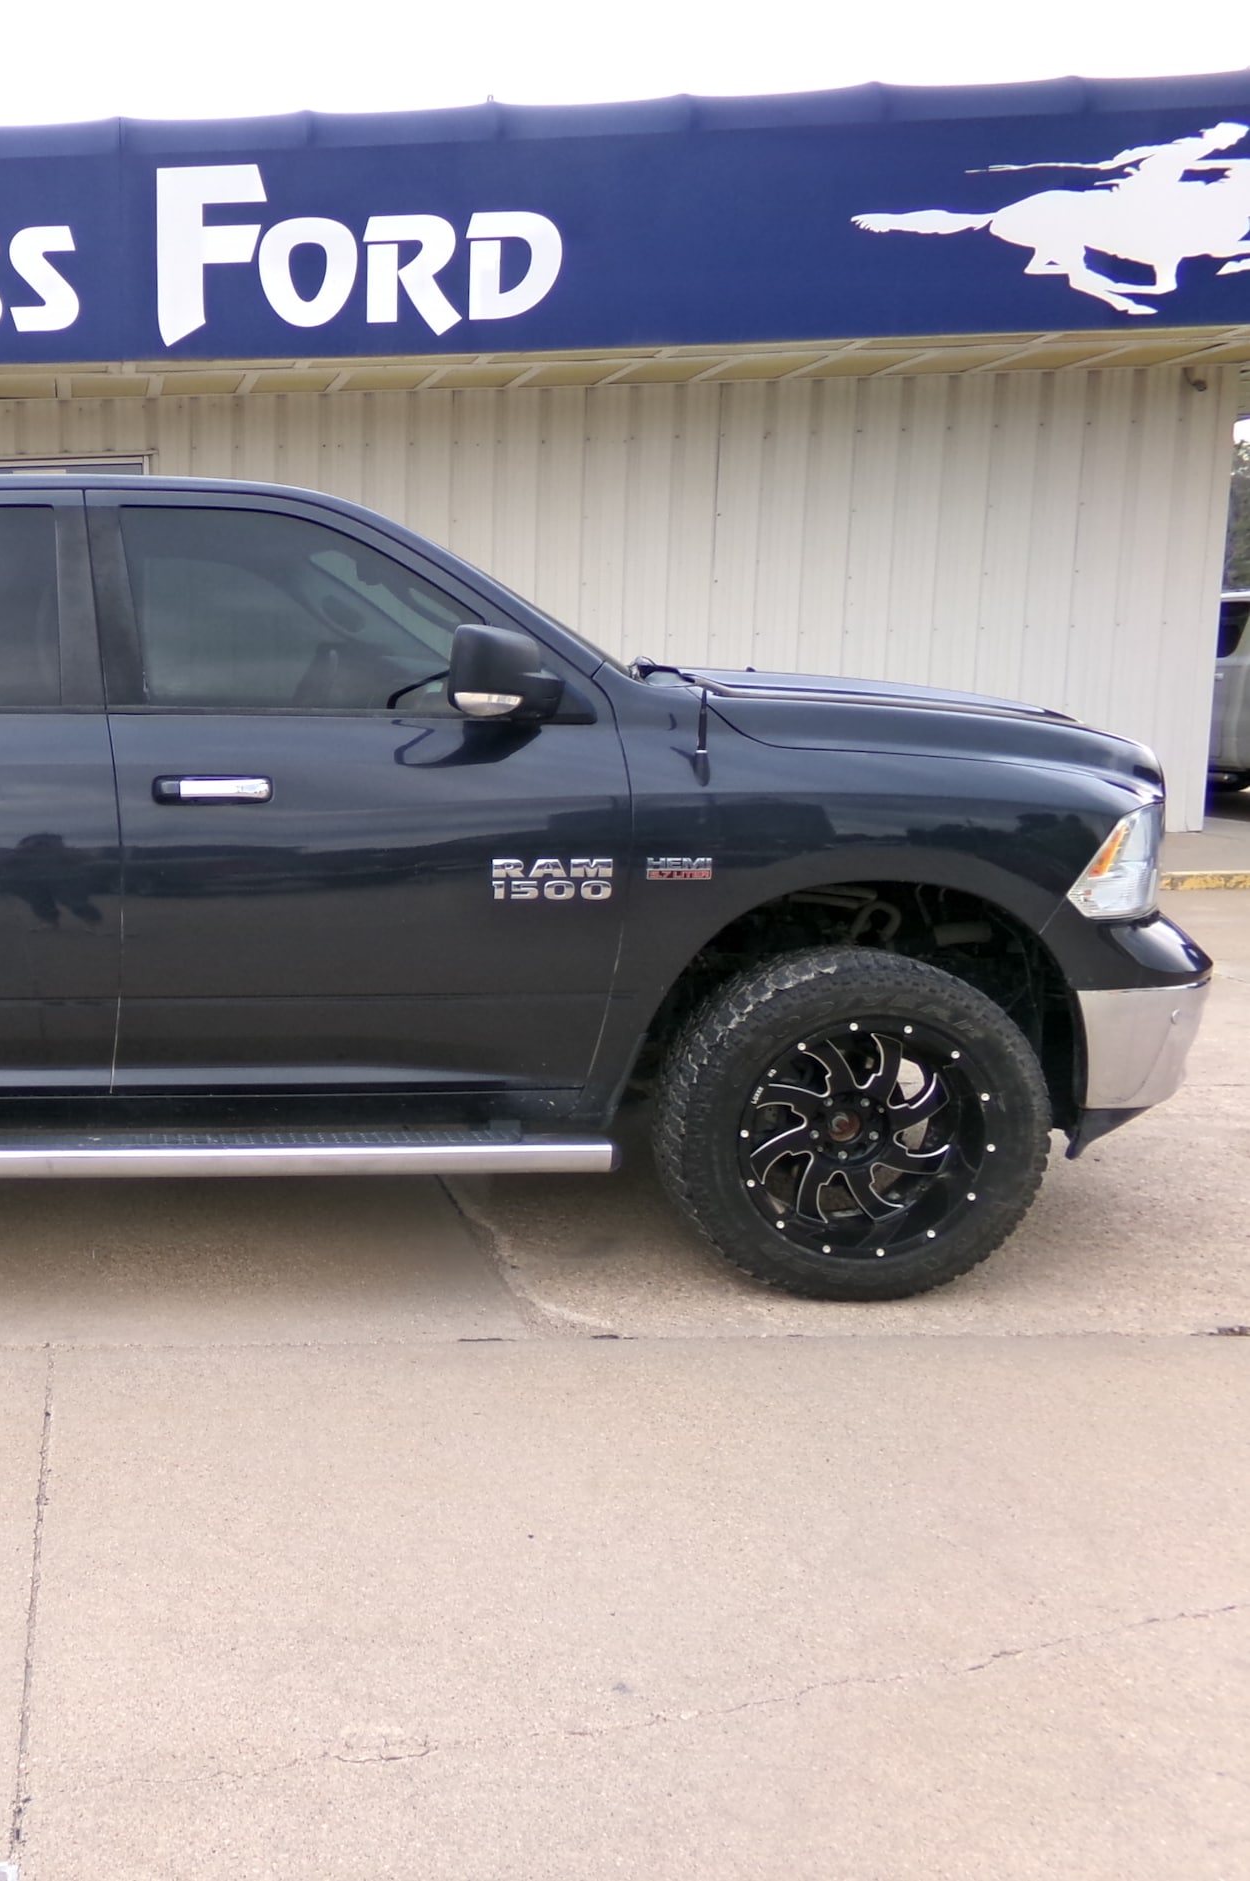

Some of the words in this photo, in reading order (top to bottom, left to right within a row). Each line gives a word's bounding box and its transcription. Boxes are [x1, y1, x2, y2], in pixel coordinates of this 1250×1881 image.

[156, 163, 563, 347] FORD
[492, 858, 613, 878] RAM
[646, 857, 712, 869] HEMI
[492, 880, 613, 900] 1500
